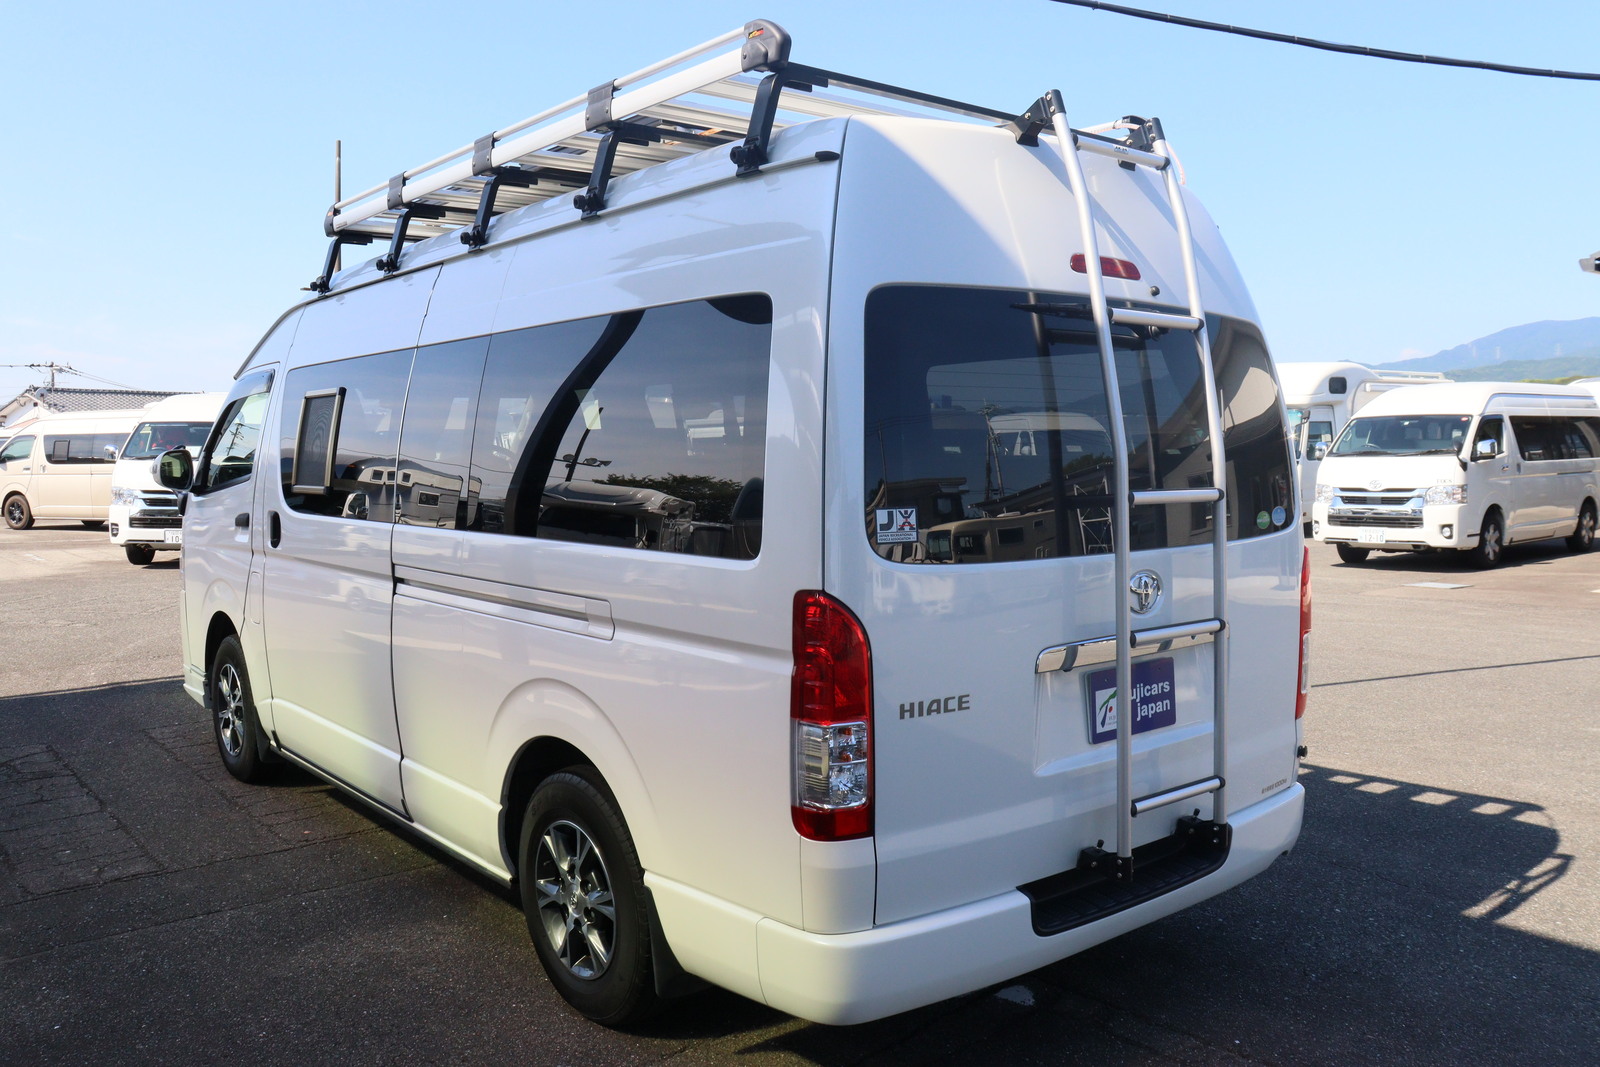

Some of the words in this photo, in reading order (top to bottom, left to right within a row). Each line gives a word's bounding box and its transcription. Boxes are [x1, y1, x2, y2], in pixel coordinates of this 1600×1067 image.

[1131, 681, 1170, 702] ujicars
[899, 694, 970, 720] HIACE
[1136, 699, 1171, 722] japan
